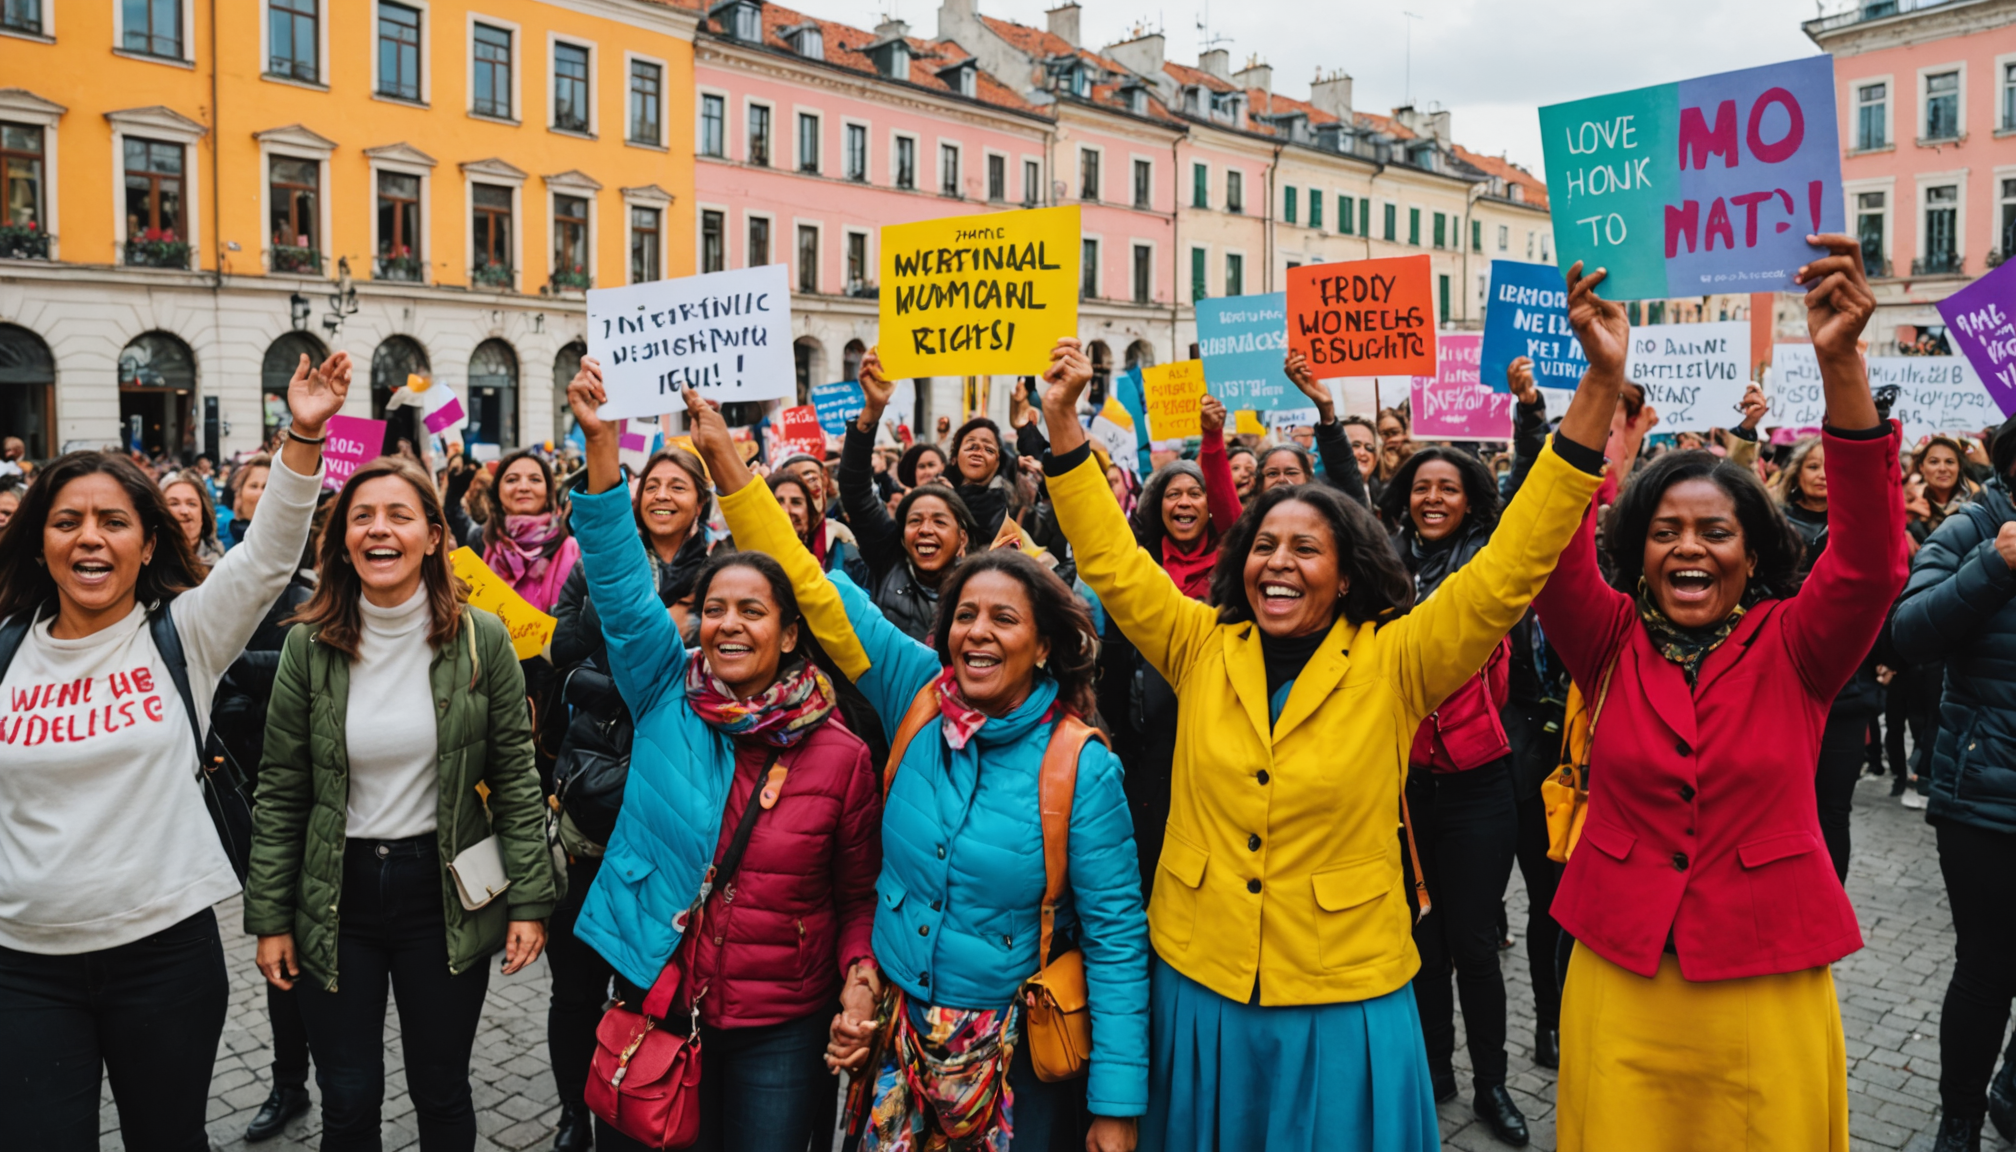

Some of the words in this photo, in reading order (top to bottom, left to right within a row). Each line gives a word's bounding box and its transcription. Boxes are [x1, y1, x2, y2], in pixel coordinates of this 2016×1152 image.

[1566, 115, 1638, 154] LOVE
[1678, 86, 1805, 172] MO
[1566, 156, 1652, 200] HONK
[1576, 212, 1628, 247] TO
